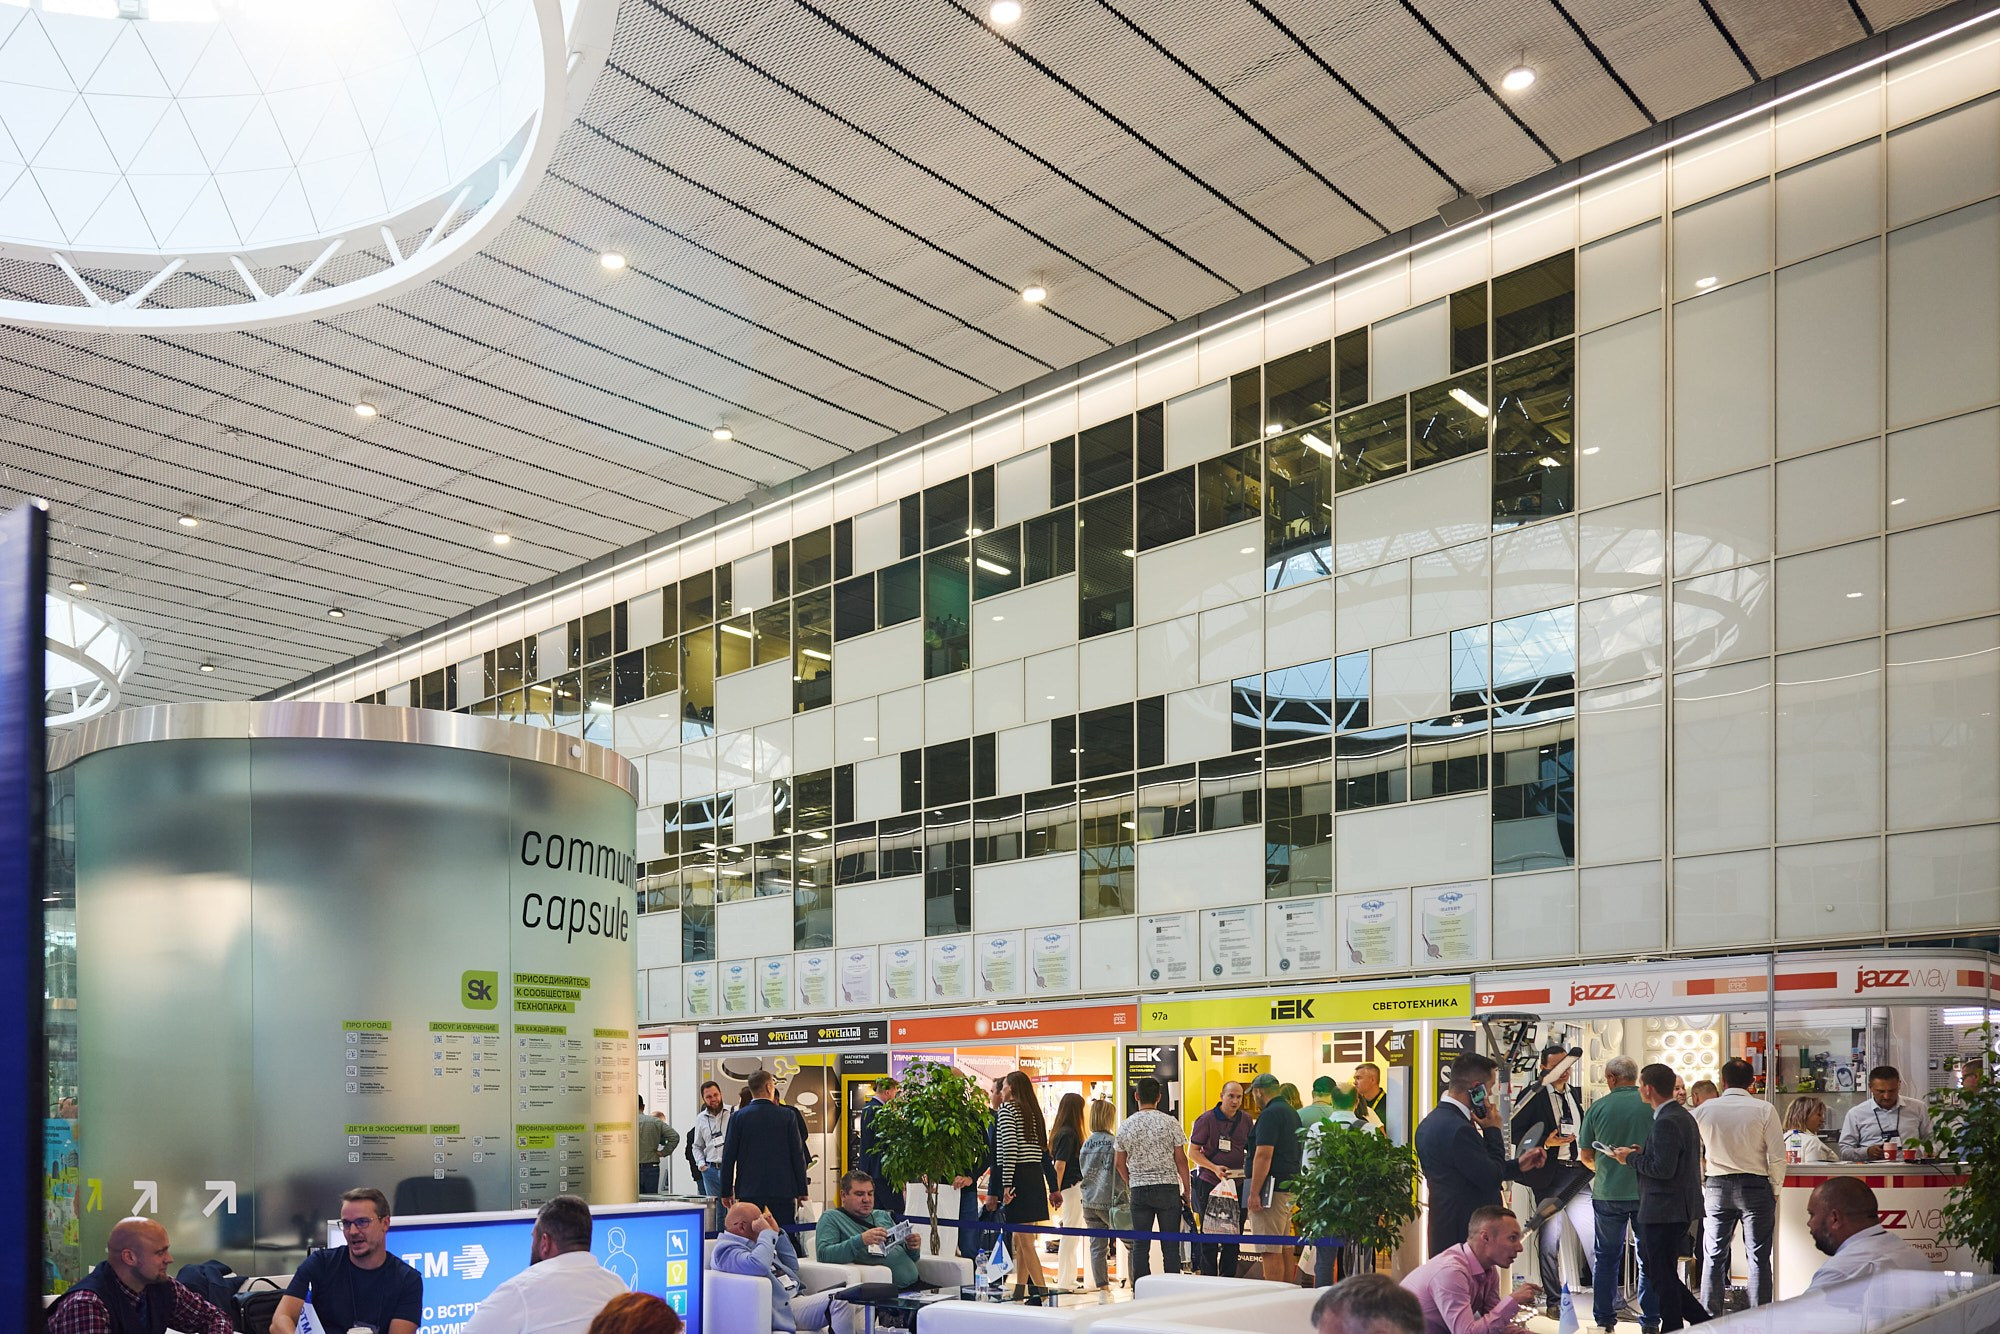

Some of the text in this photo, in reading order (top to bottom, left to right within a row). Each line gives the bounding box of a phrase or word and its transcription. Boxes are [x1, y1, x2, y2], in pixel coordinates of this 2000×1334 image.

[522, 893, 629, 944] capsule
[516, 975, 589, 986] ПРИСОЕДИНЯЙТЕСЬ
[1855, 965, 1950, 993] jazzway
[467, 979, 492, 1001] Sk
[516, 988, 580, 998] К СООБЩЕСТВАМ
[1568, 980, 1661, 1006] jazzway
[1373, 998, 1458, 1010] СВЕТОТЕХНИКА
[1482, 995, 1495, 1004] 97
[517, 1002, 567, 1011] ТЕХНОПАРКА
[991, 1019, 1038, 1032] LEDVANCE
[898, 1028, 907, 1036] 98
[638, 1043, 651, 1051] TON
[1211, 1036, 1234, 1055] 25
[402, 1251, 448, 1278] ТМ
[416, 1322, 467, 1334] ОРУМЕ
